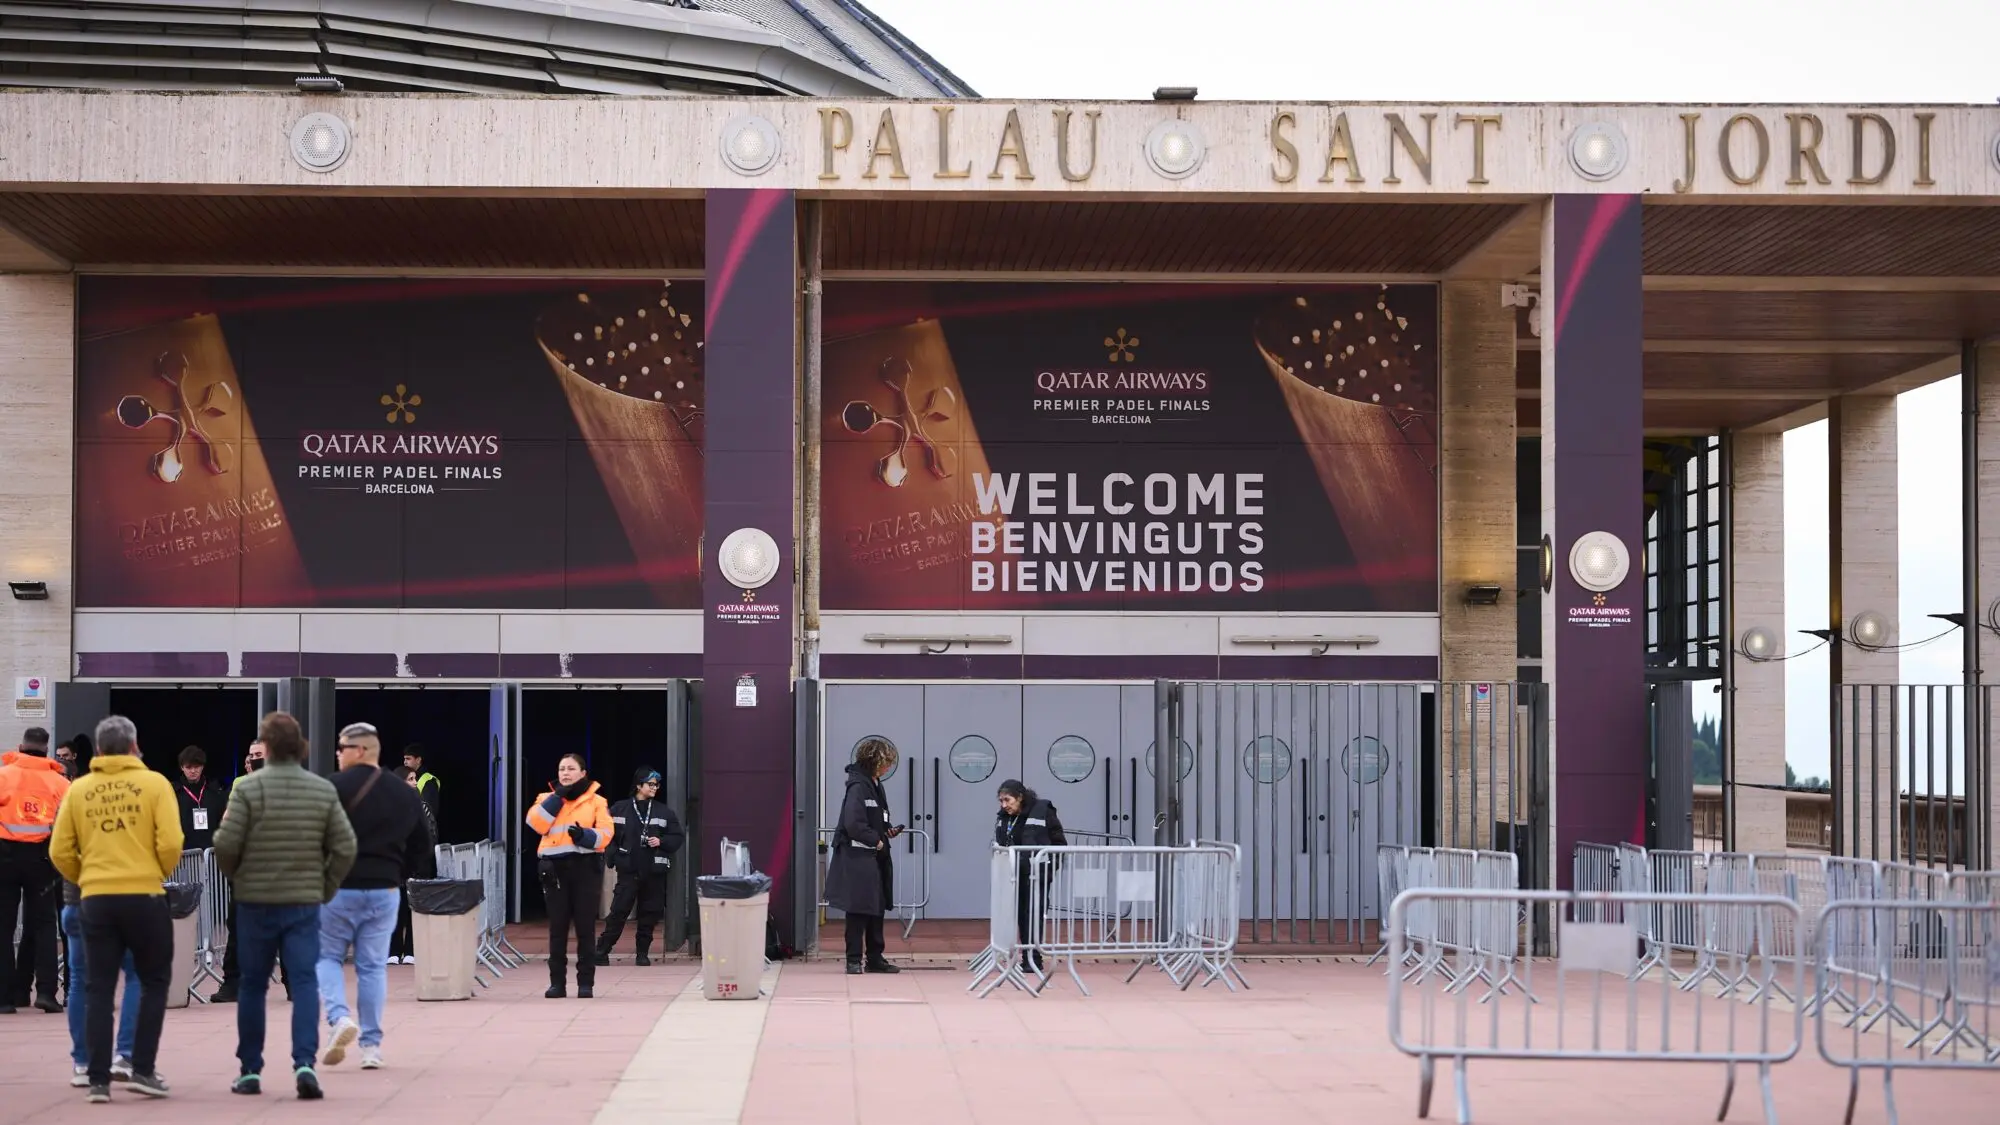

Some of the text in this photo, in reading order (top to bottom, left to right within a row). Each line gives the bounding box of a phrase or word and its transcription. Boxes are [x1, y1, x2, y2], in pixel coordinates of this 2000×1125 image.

[817, 106, 1936, 194] PALAU SANT JORDI
[1037, 371, 1207, 392] QATAR AIRWAYS
[1033, 399, 1210, 411] PREMIER PADEL FINALS
[1091, 415, 1151, 424] BARCELONA
[303, 434, 499, 457] QATAR AIRWAYS
[298, 465, 502, 479] PREMIER PADEL FINALS
[365, 484, 434, 494] BARCELONA
[972, 472, 1264, 515] WELCOME
[971, 522, 1264, 555] BENVINGUTS
[971, 561, 1264, 594] BIENVENIDOS
[718, 604, 779, 613] QATAR AIRWAYS
[1569, 608, 1596, 616] QATAR
[86, 804, 141, 818] CULTURE
[101, 817, 126, 833] CA
